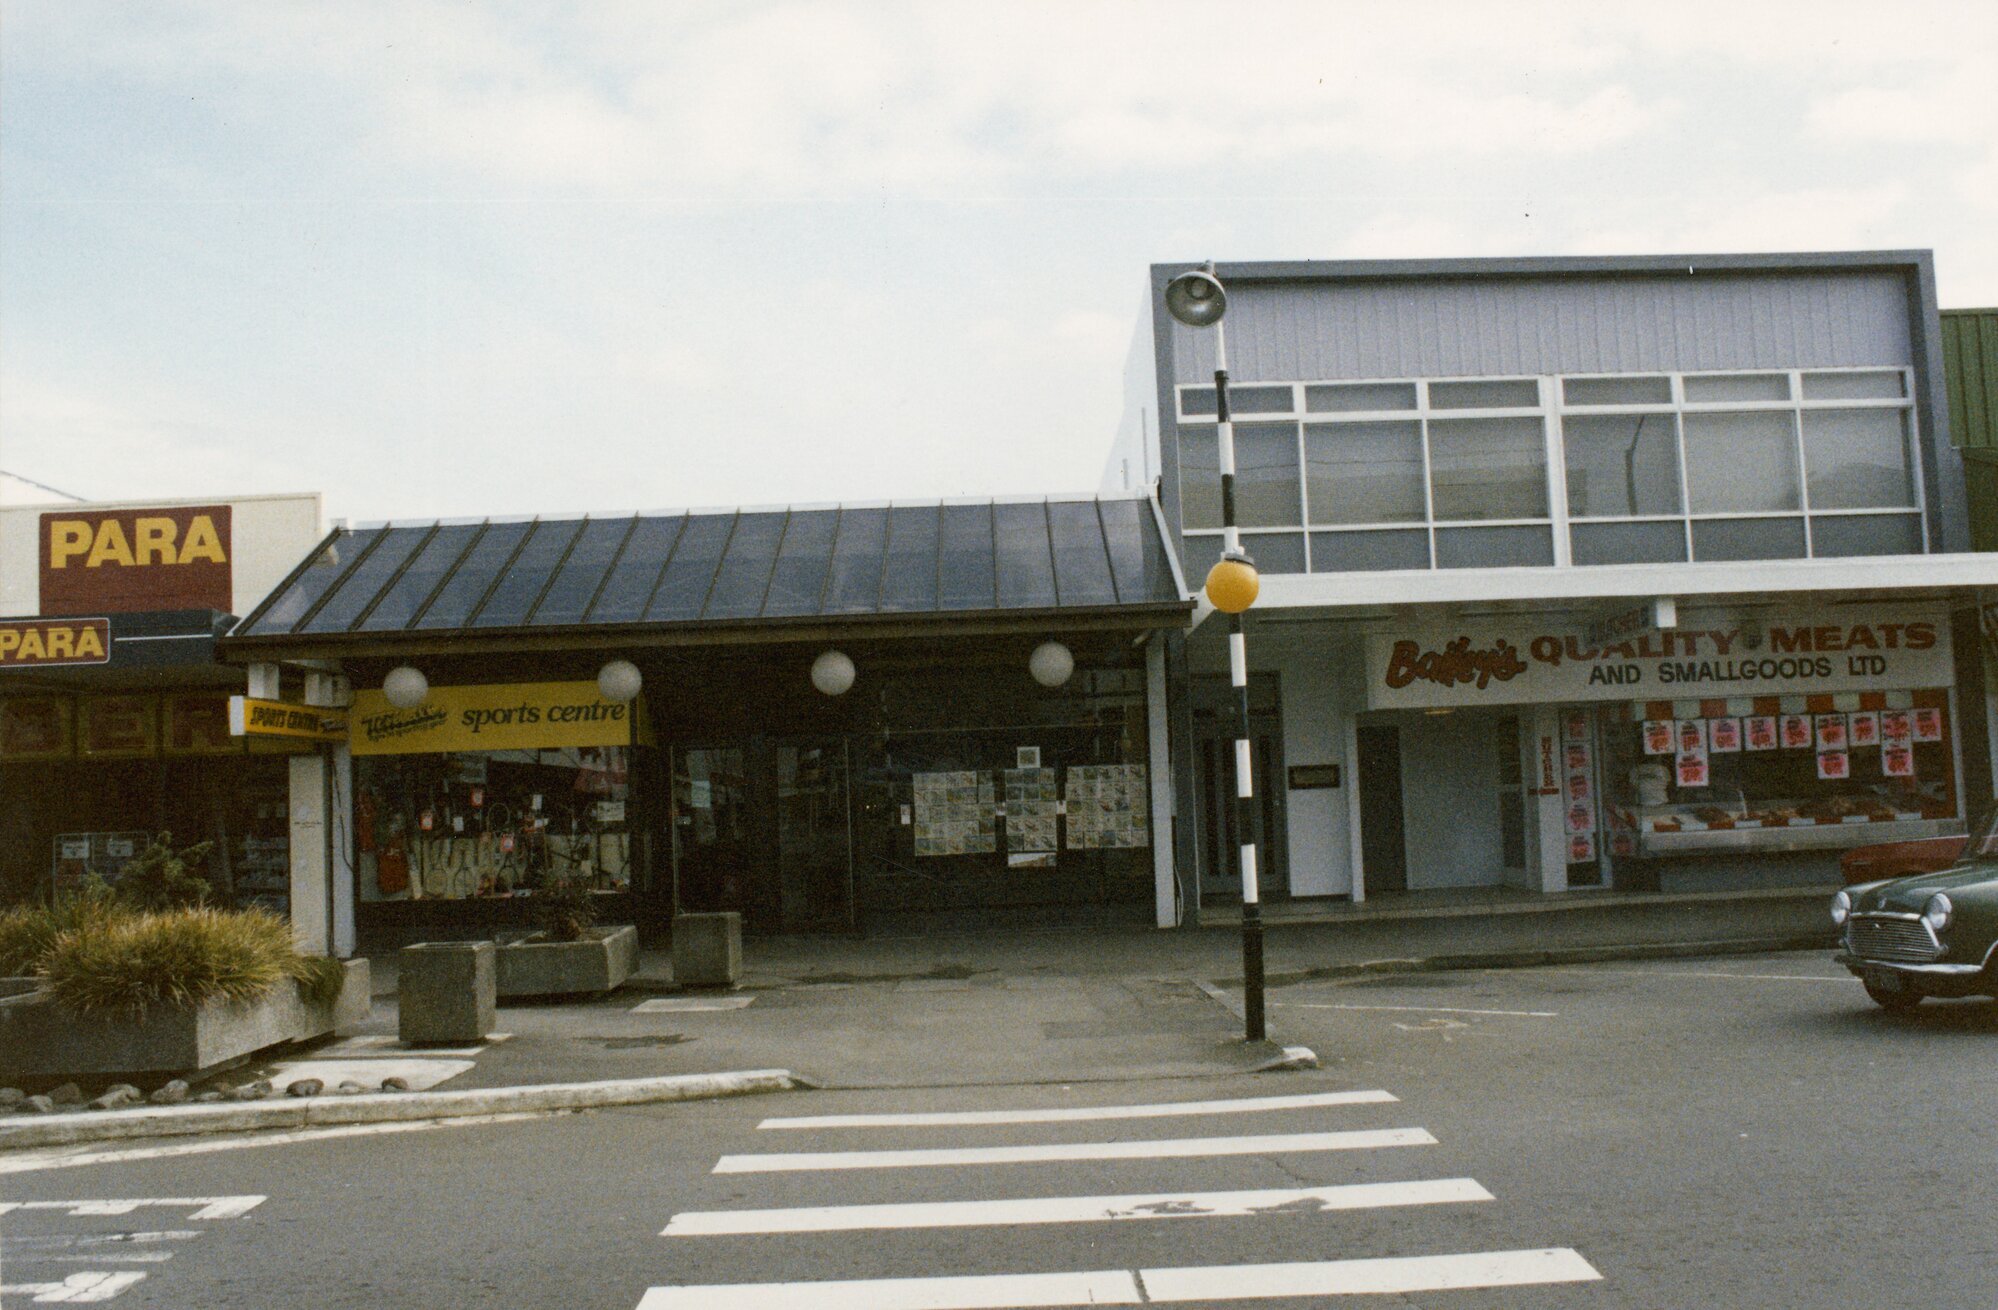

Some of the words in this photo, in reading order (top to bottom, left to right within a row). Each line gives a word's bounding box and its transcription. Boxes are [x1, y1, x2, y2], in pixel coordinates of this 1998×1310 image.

[50, 515, 227, 569] PARA
[0, 626, 105, 660] PARA
[1530, 629, 1739, 667] QUALITY
[1769, 622, 1937, 653] MEATS
[1589, 664, 1642, 686] AND
[1658, 656, 1832, 683] SMALLGOODS
[1847, 655, 1887, 676] LTD
[250, 706, 287, 728] SPORTS
[461, 702, 540, 733] sports
[547, 702, 626, 722] centre
